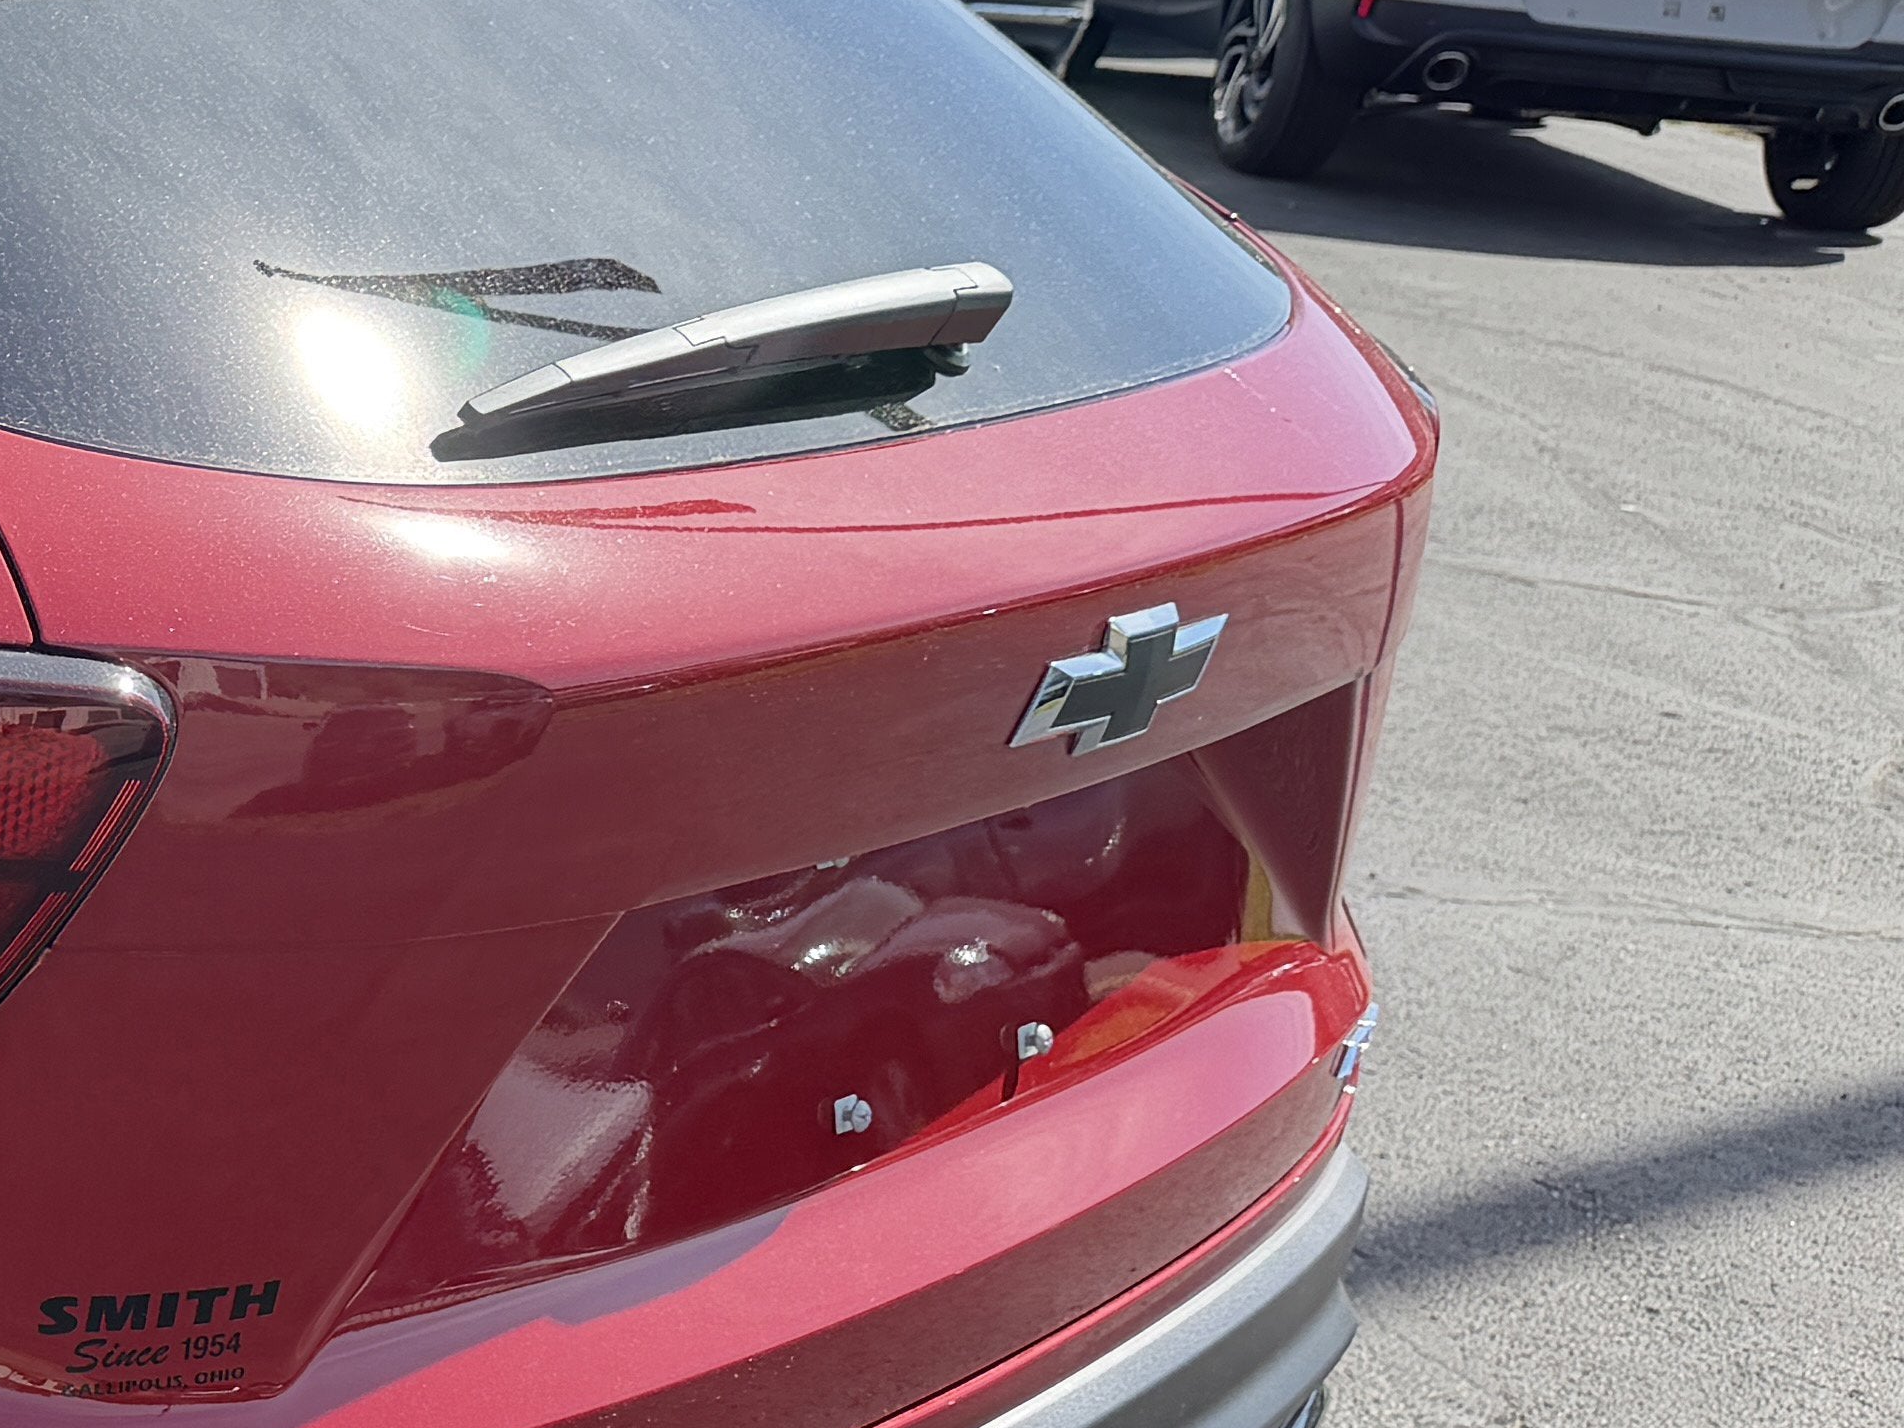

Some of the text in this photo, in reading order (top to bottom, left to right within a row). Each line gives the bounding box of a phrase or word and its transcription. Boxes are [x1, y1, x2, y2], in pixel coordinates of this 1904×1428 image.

[37, 1280, 281, 1335] SMITH
[65, 1332, 241, 1373] Since 1954
[194, 1367, 245, 1385] OHIO
